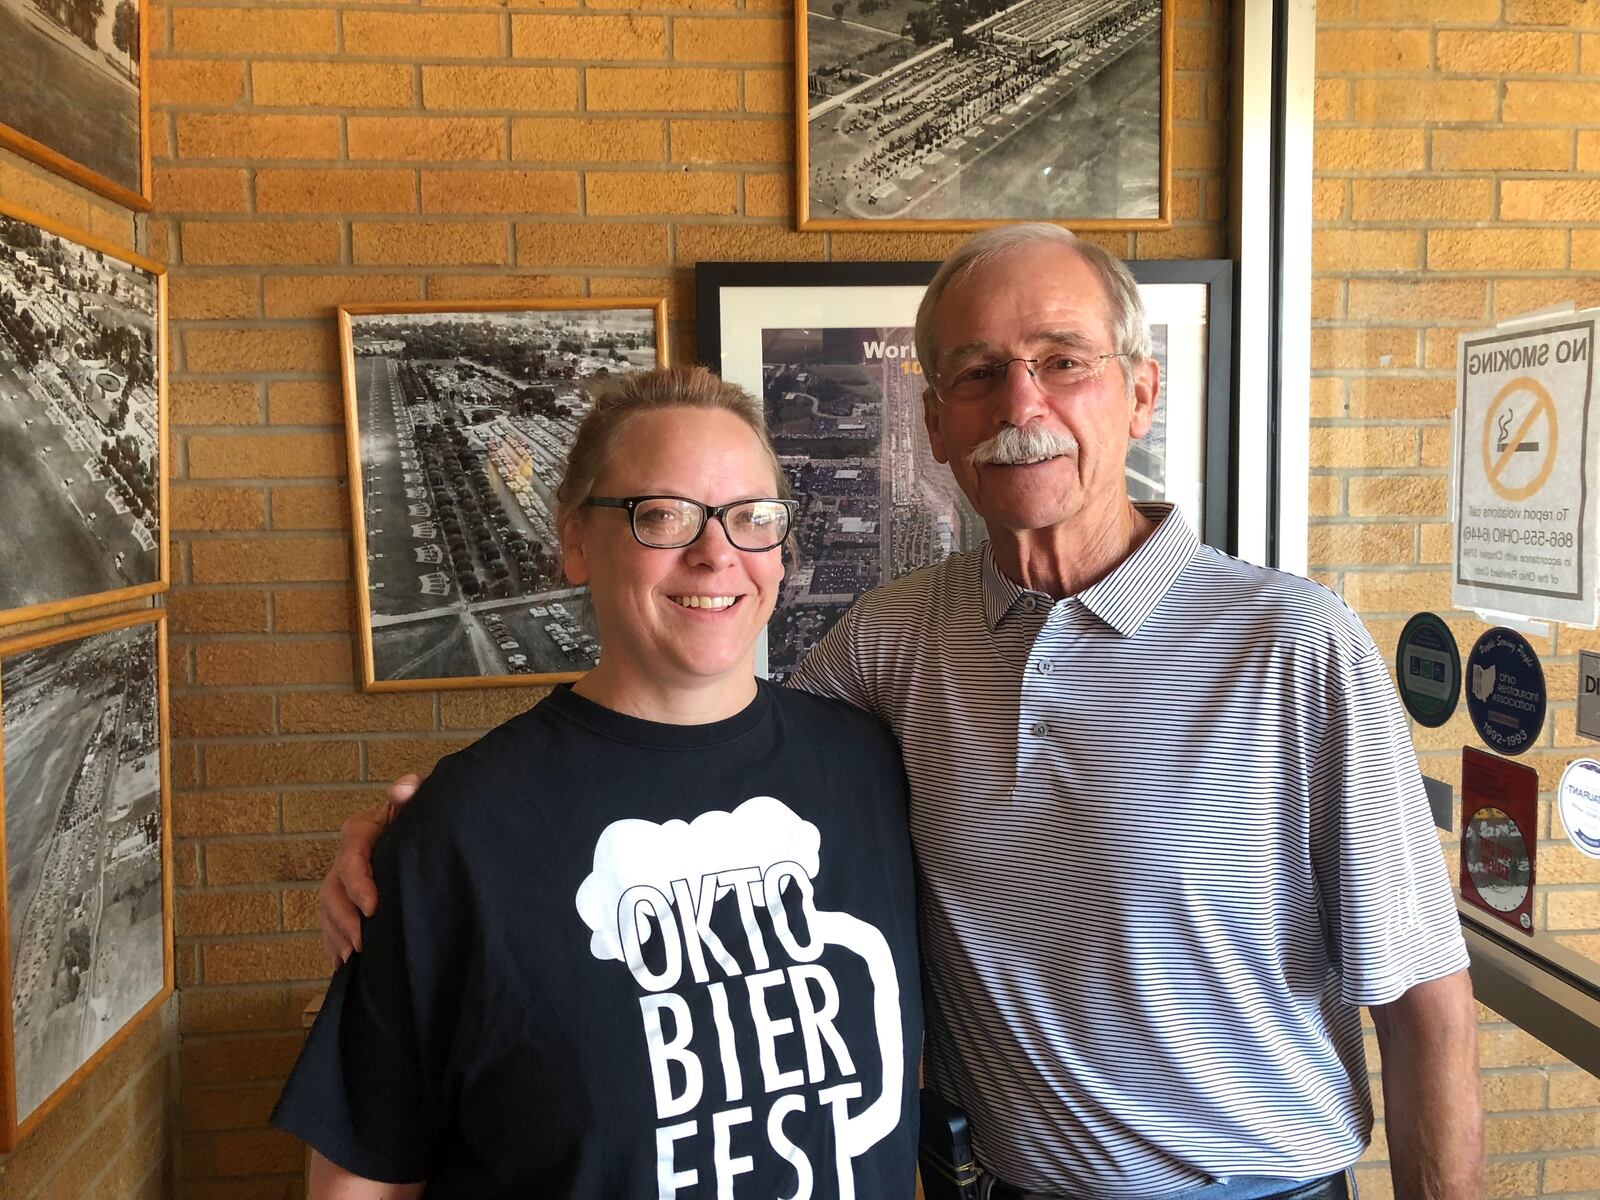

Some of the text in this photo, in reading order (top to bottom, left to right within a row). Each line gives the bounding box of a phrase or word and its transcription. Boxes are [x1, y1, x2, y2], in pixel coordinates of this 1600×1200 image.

[1483, 721, 1528, 748] 1992-1993
[617, 860, 825, 992] OKTO
[639, 963, 857, 1120] BIER
